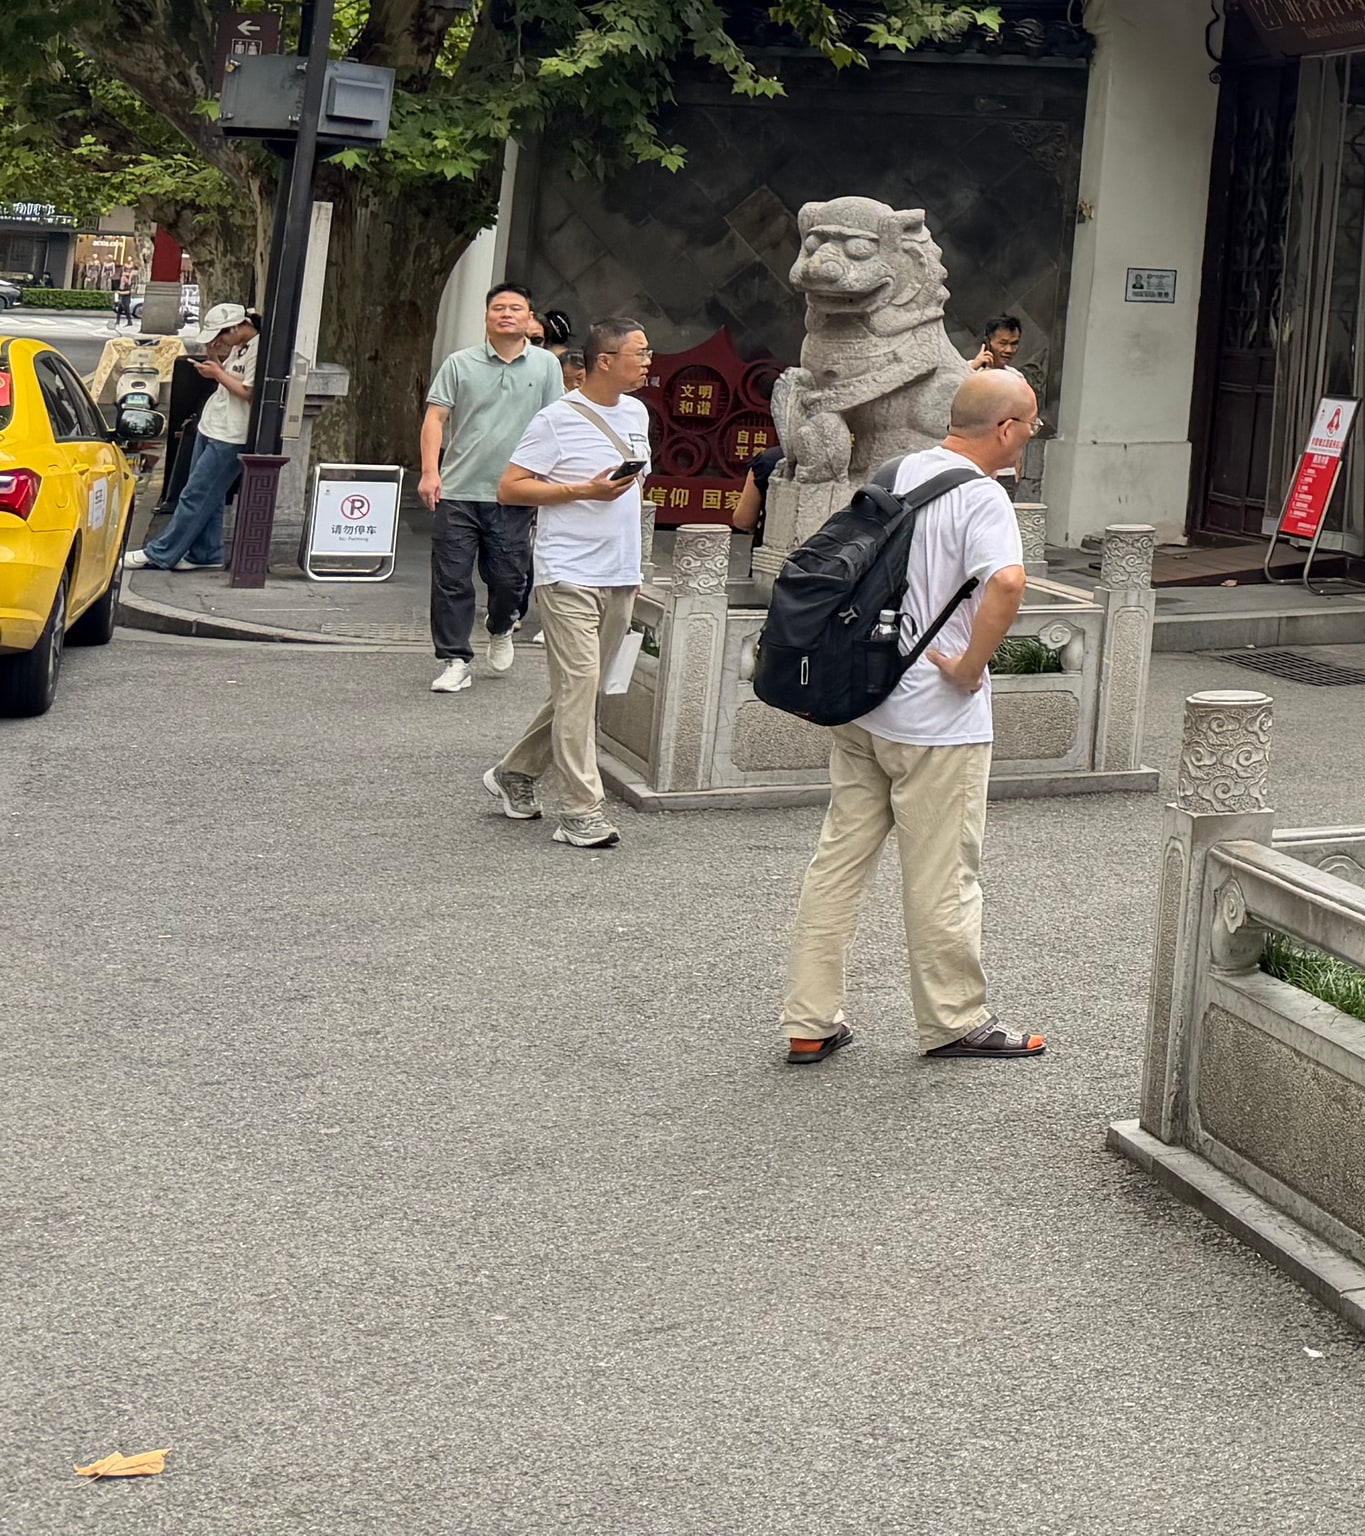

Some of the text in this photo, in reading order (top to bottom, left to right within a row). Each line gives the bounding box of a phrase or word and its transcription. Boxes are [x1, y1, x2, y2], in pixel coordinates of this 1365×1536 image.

[680, 384, 713, 400] 文明
[679, 400, 711, 415] 和谐
[737, 430, 768, 445] 自由
[643, 487, 742, 511] 信仰 国家
[331, 525, 377, 535] 请勿停车
